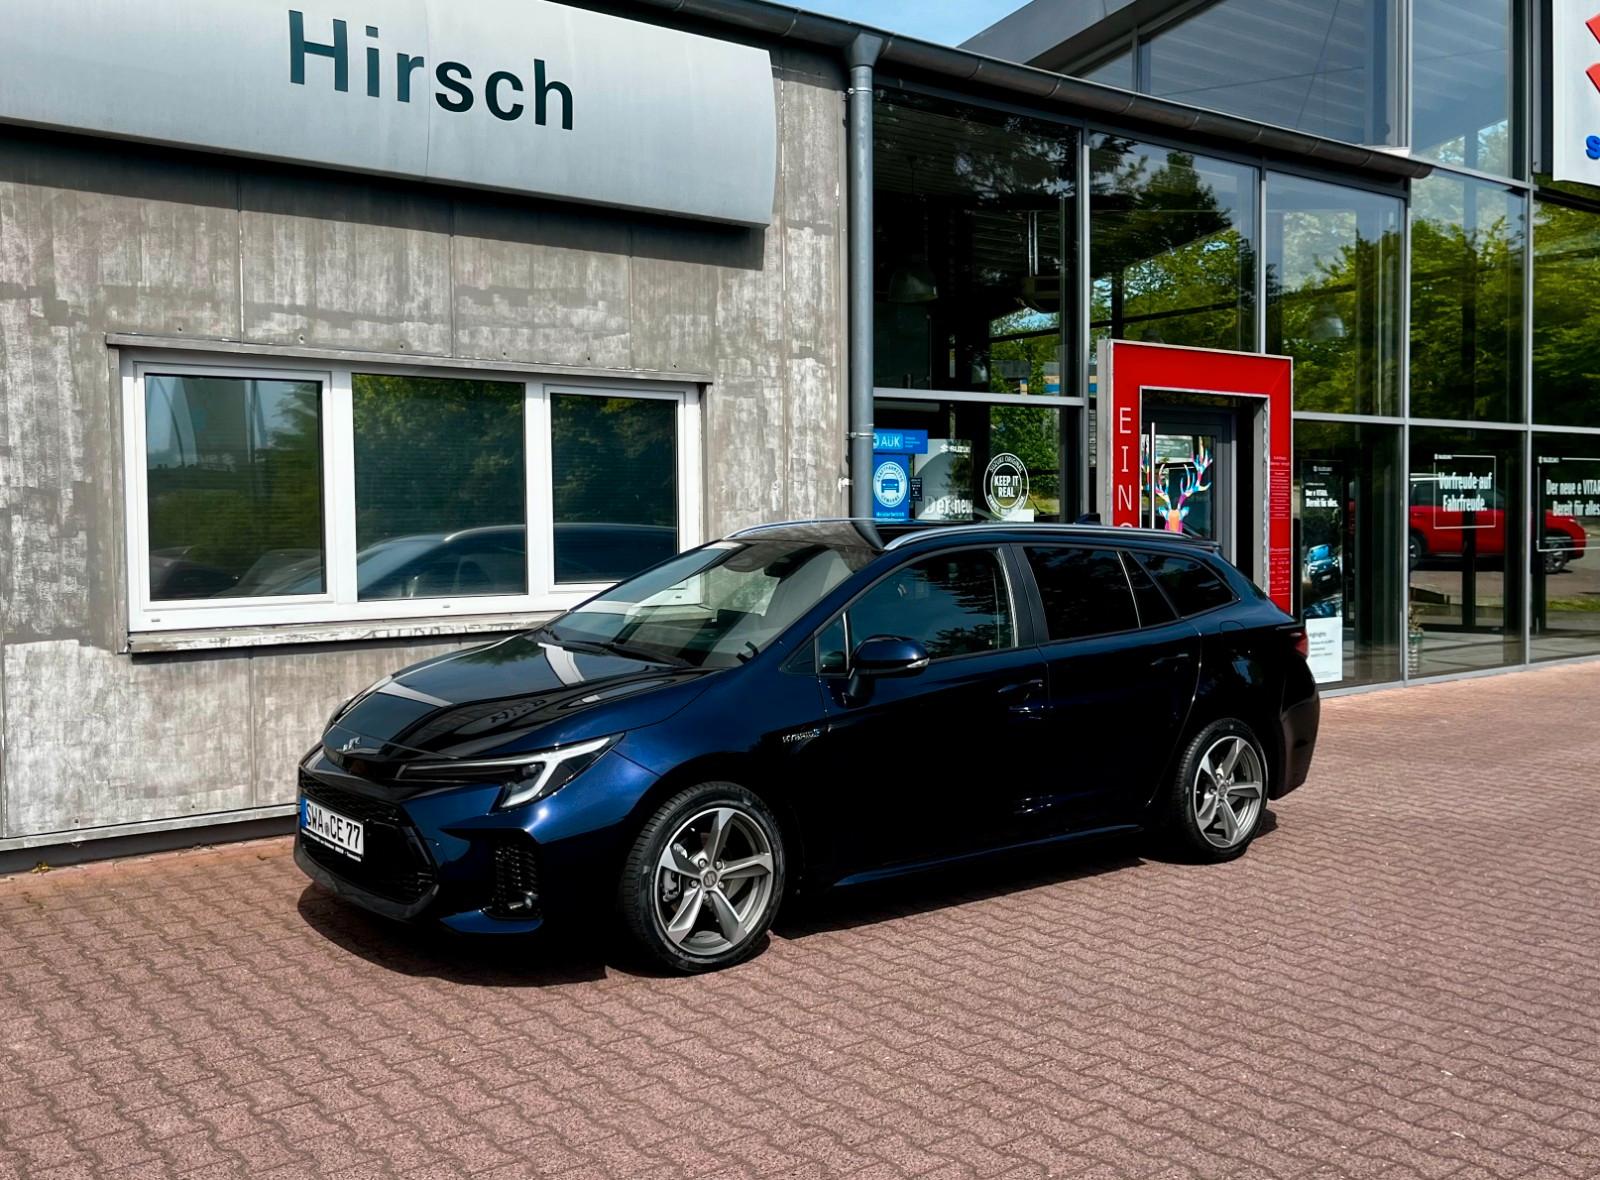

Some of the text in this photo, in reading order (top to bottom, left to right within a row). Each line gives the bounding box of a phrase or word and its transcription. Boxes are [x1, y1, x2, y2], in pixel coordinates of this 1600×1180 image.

[288, 9, 573, 131] Hirsch
[880, 435, 900, 447] AUK
[988, 455, 1024, 474] SUZUKI ORIGINAL
[1118, 406, 1133, 527] EIN
[994, 475, 1019, 486] KEEP IT
[1438, 472, 1493, 489] Vorfreude auf
[1546, 479, 1558, 495] Der
[1559, 482, 1576, 495] neue
[1577, 482, 1582, 495] e
[998, 486, 1015, 498] REAL
[924, 496, 949, 514] Der
[1442, 494, 1487, 512] Fahrfreude.
[1552, 500, 1573, 516] Bereit
[1574, 500, 1584, 516] für
[305, 802, 324, 834] SWA
[330, 815, 344, 844] CE
[346, 821, 361, 850] 77
